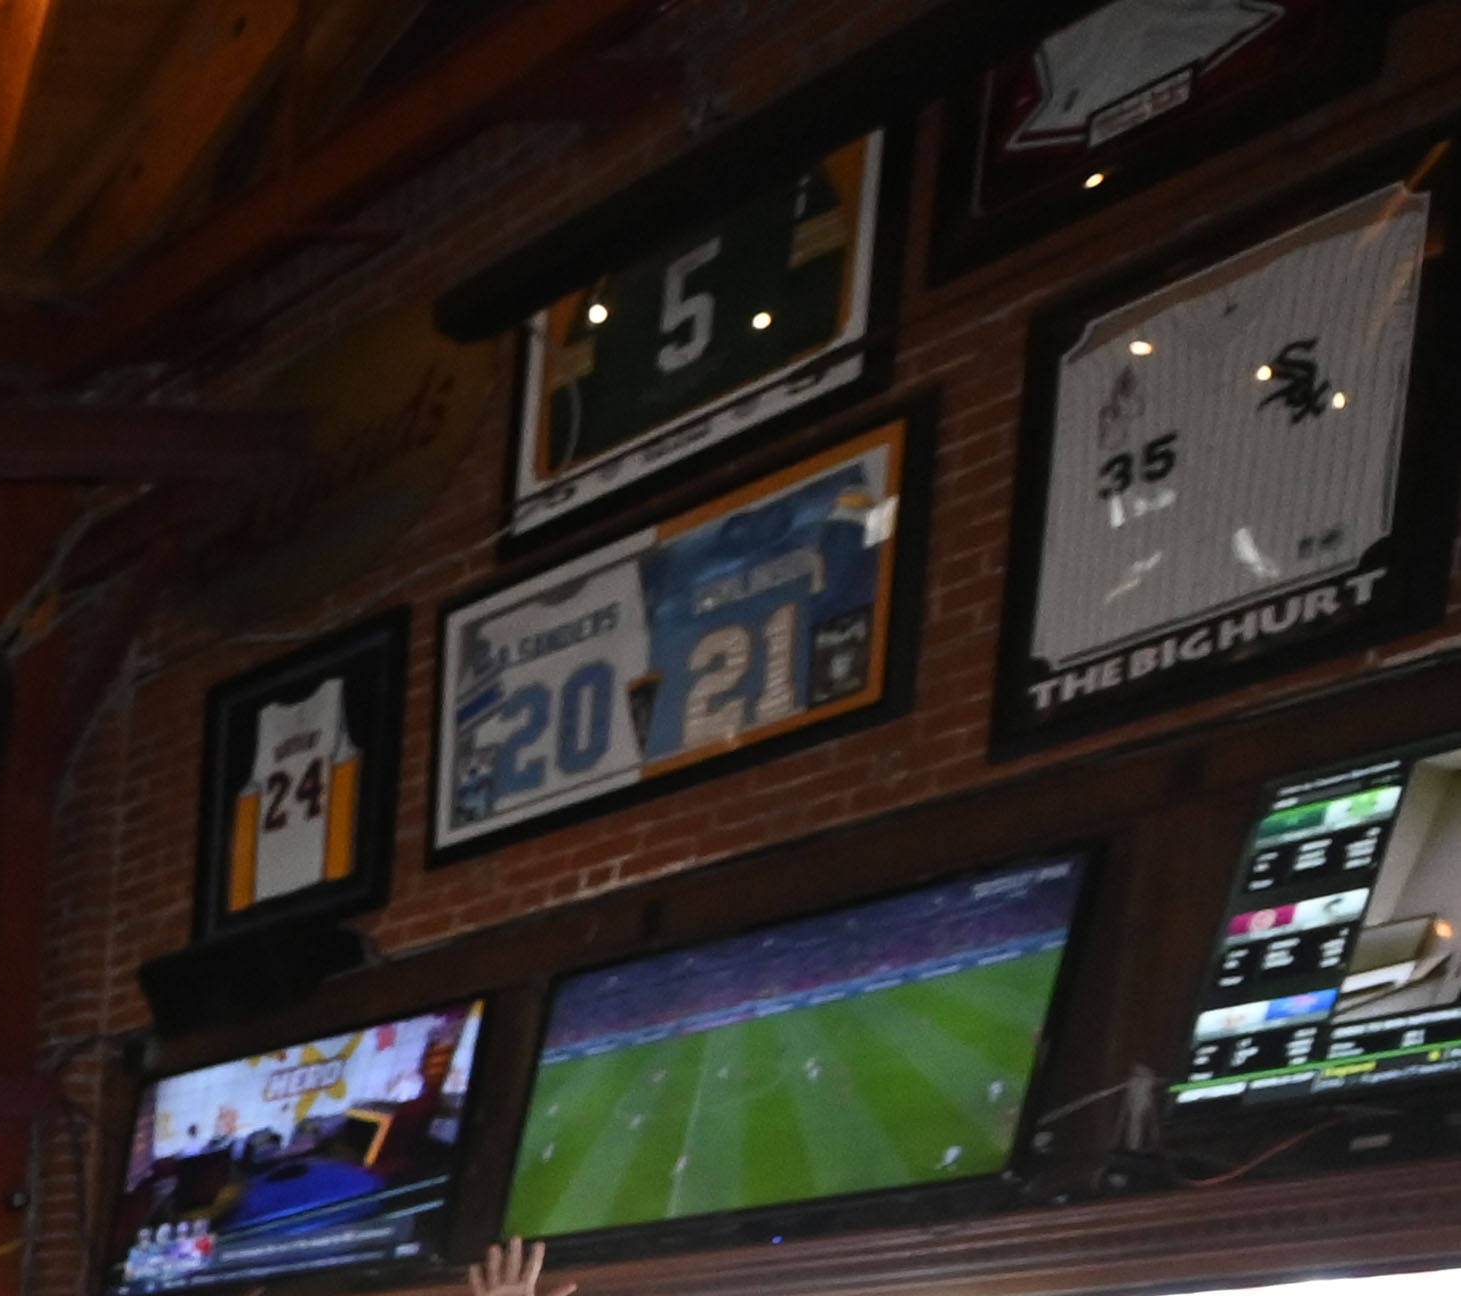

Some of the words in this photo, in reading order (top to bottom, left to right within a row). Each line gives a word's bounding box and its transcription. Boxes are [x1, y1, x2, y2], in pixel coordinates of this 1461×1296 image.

[657, 237, 721, 372] 5
[1096, 434, 1178, 500] 35
[682, 602, 802, 753] 21
[1028, 661, 1123, 709] THE
[1128, 624, 1212, 675] BIG
[1220, 569, 1387, 646] HURT
[259, 755, 325, 833] 24
[489, 660, 614, 796] 20
